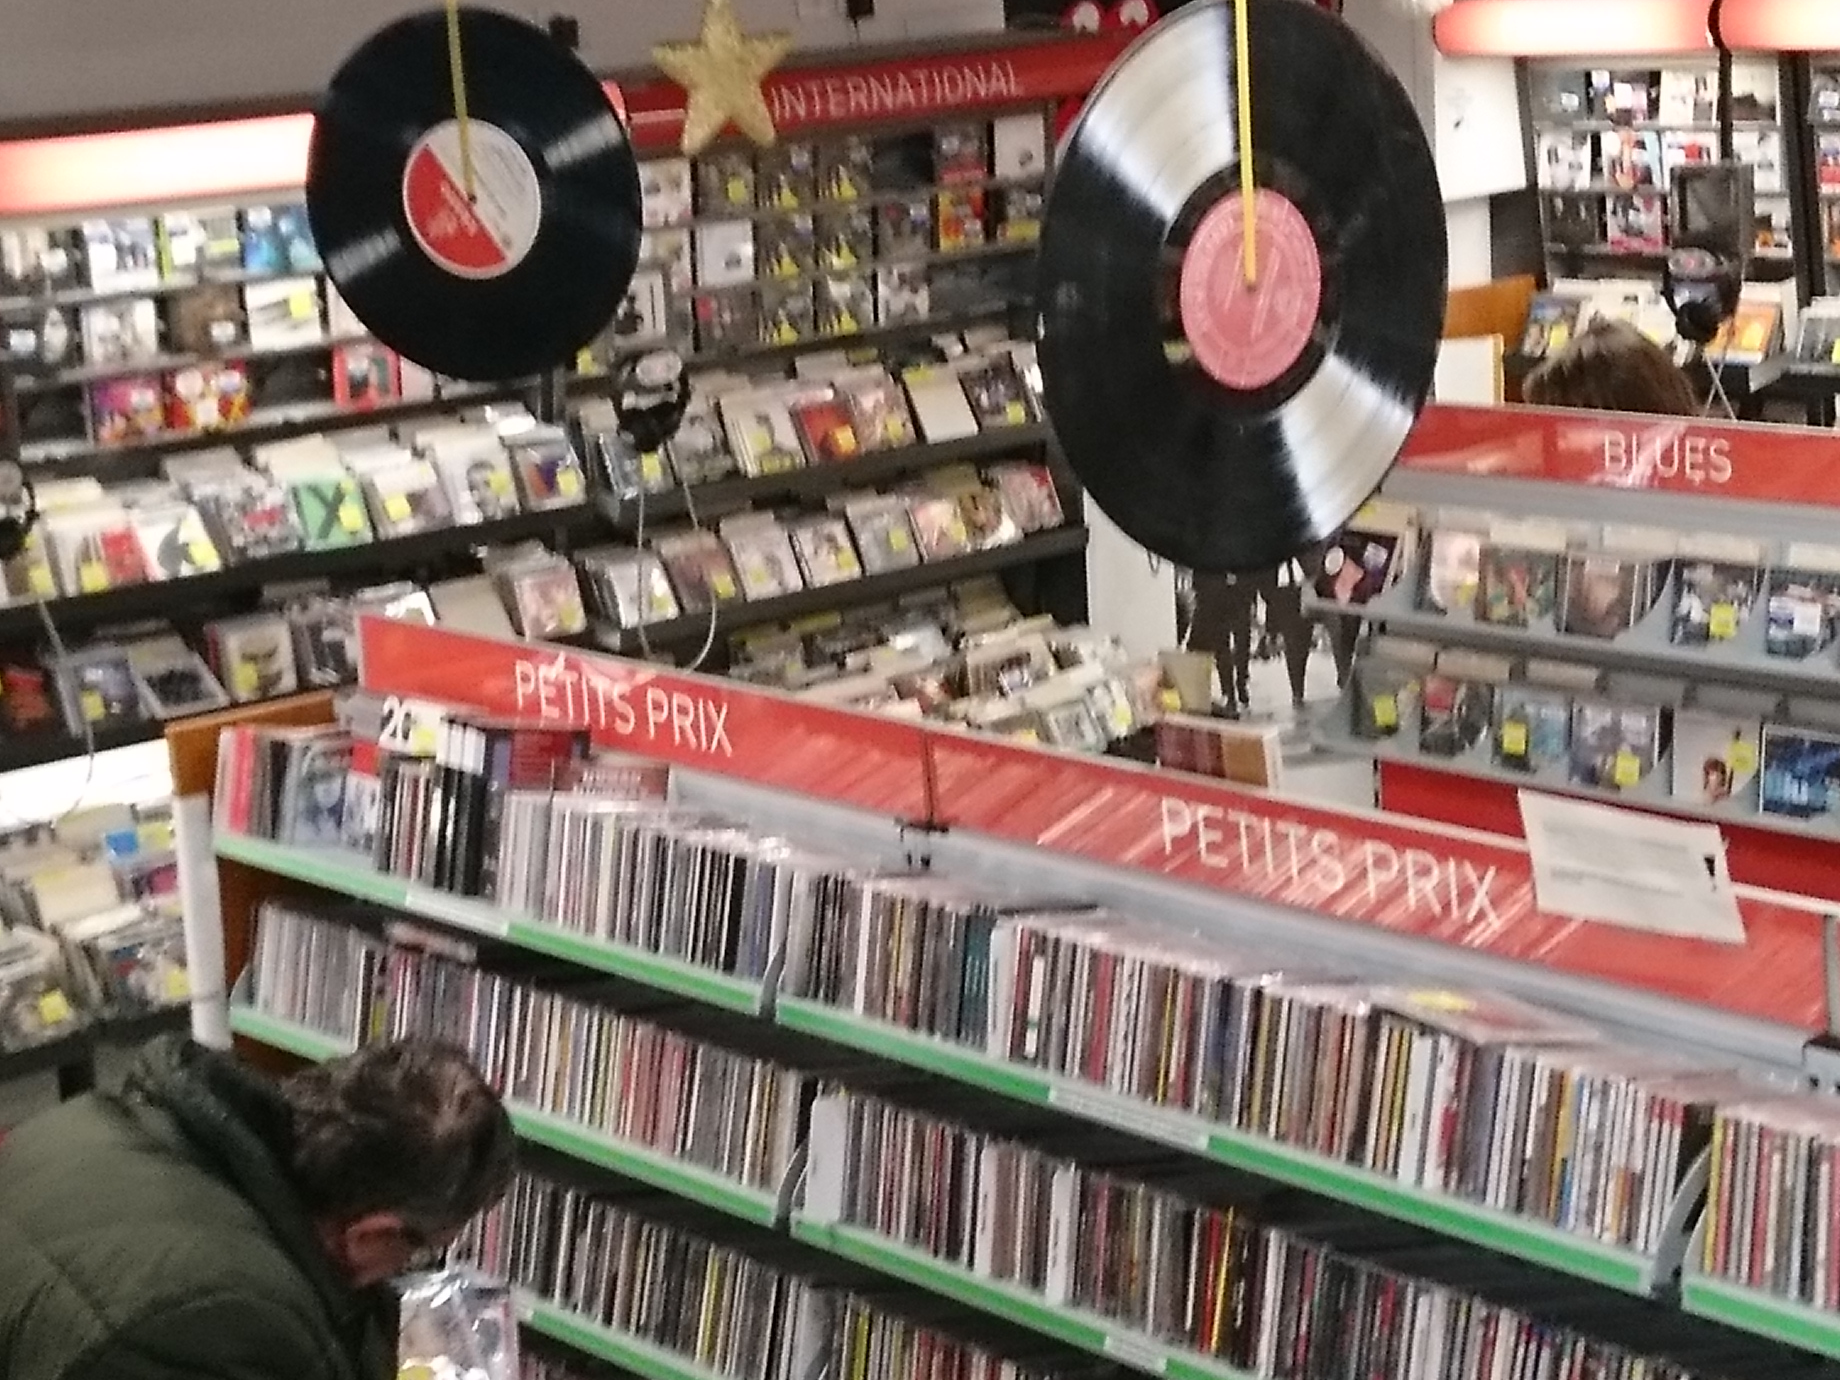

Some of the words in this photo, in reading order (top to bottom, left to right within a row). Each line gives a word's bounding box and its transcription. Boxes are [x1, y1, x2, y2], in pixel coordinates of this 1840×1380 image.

[771, 60, 1026, 120] INTERNATIONAL
[1604, 431, 1733, 484] BLUES
[515, 658, 635, 735] PETITS
[646, 686, 733, 758] PRIX
[1161, 797, 1347, 895] PETITS
[1363, 840, 1501, 927] PRIX
